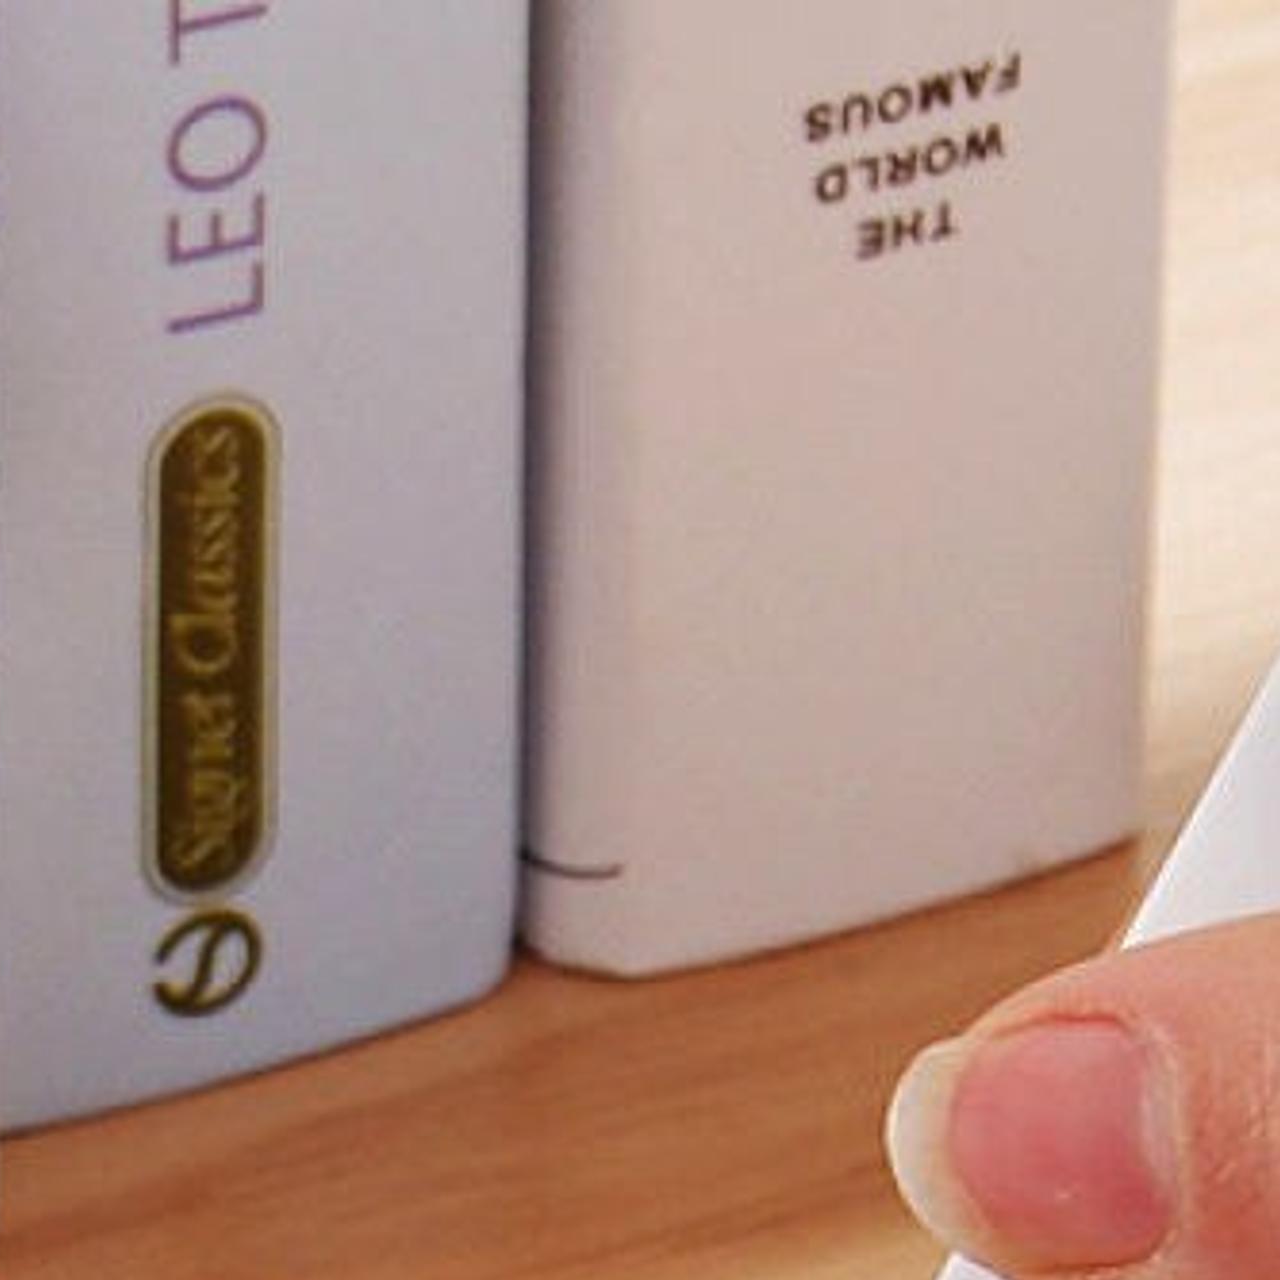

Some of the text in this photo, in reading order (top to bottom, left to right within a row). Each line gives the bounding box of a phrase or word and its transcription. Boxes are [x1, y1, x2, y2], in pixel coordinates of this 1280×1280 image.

[804, 55, 1020, 142] FAMOUS
[815, 124, 1002, 203] WORLD
[165, 96, 267, 335] LEO
[858, 203, 953, 259] THE
